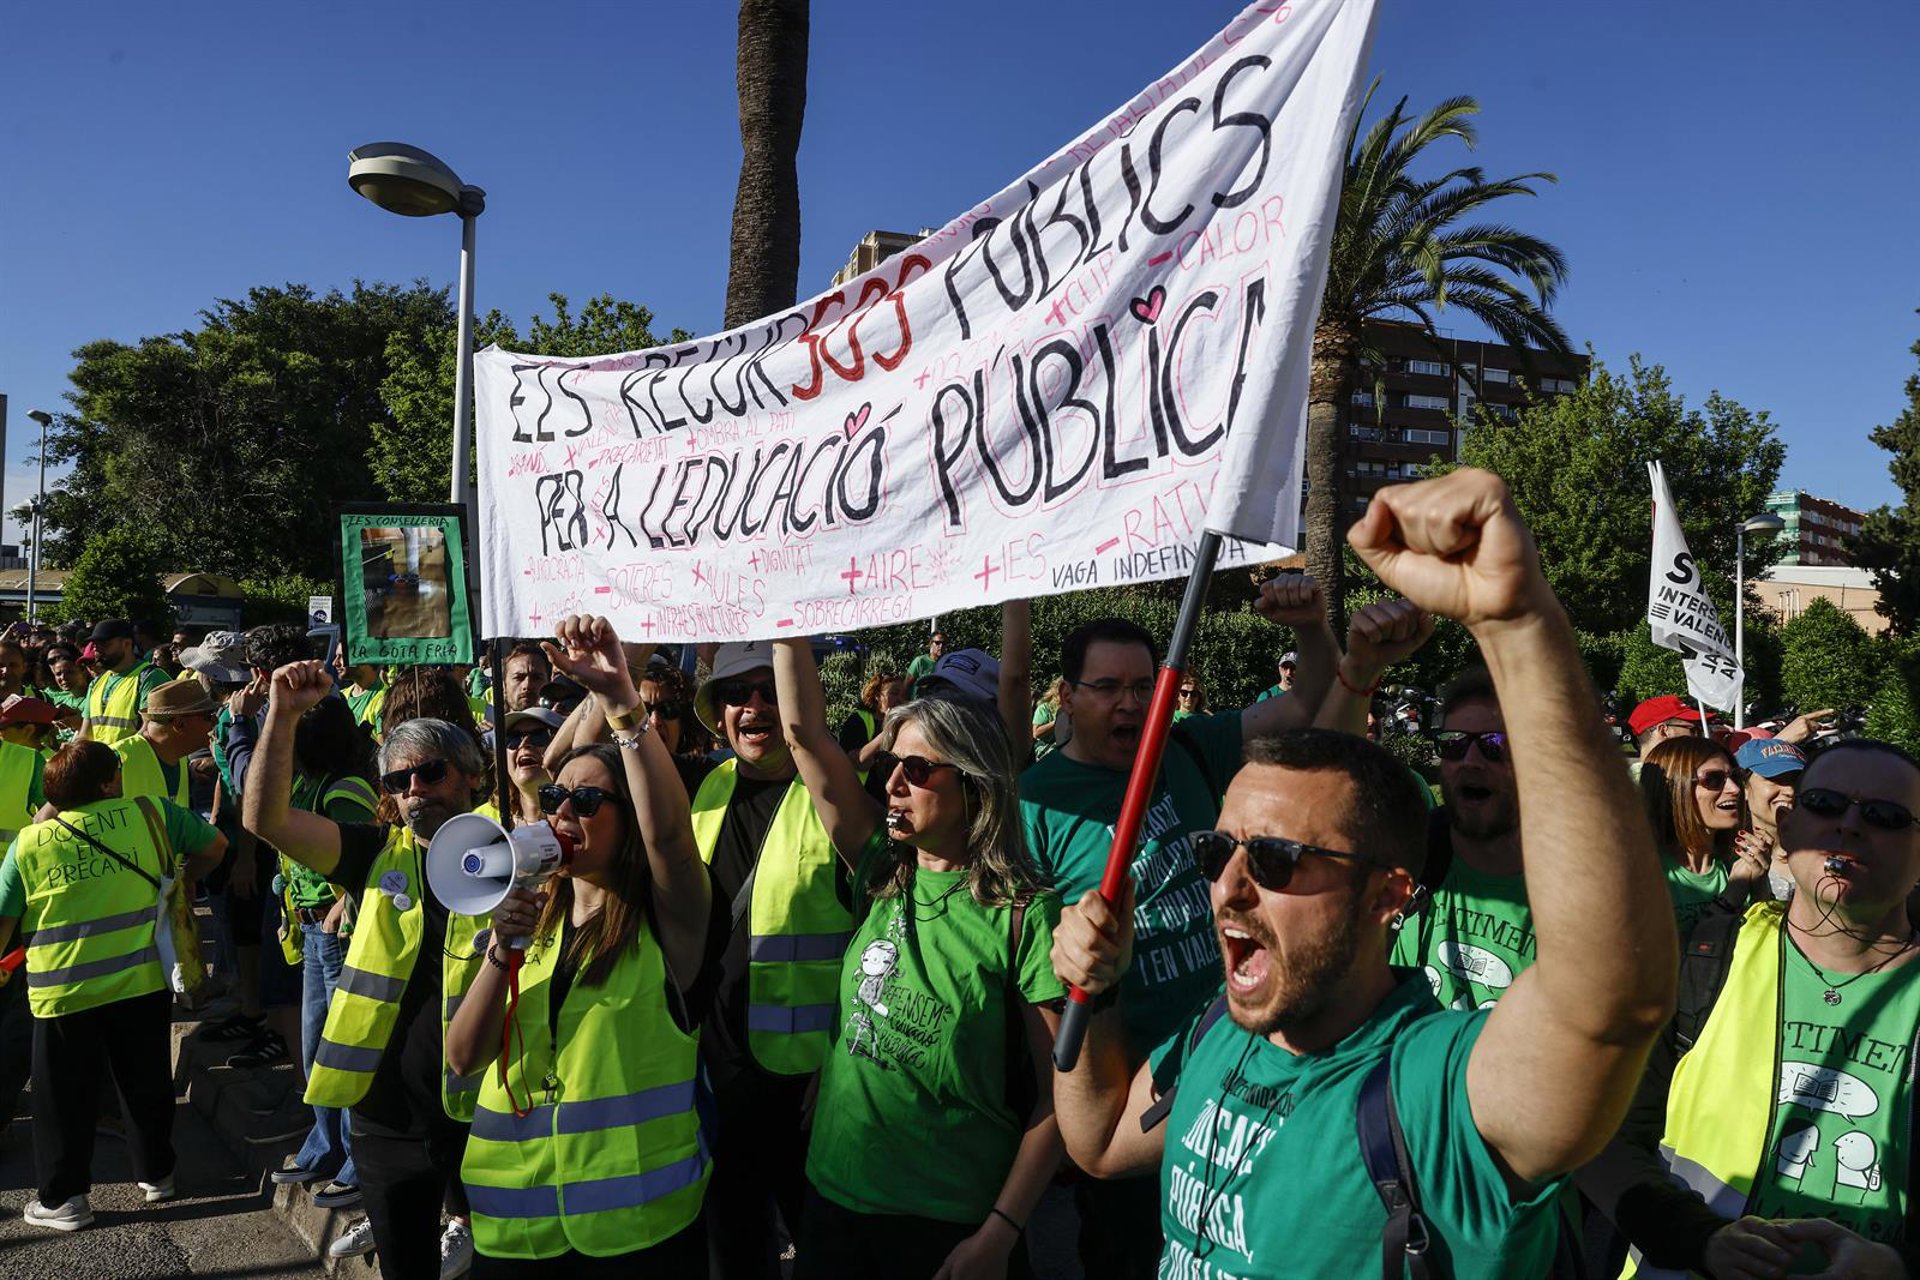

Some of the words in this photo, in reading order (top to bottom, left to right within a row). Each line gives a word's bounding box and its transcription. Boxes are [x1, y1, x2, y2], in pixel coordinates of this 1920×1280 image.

[510, 363, 593, 443] ELS
[536, 469, 588, 556] PER
[603, 463, 638, 551] A
[640, 404, 902, 549] L'EDUCACIÓ
[1052, 559, 1097, 589] VAGA
[1658, 586, 1720, 625] INTERS
[1156, 877, 1212, 932] QUALIT
[1151, 943, 1180, 984] EN
[1178, 928, 1222, 973] VALE
